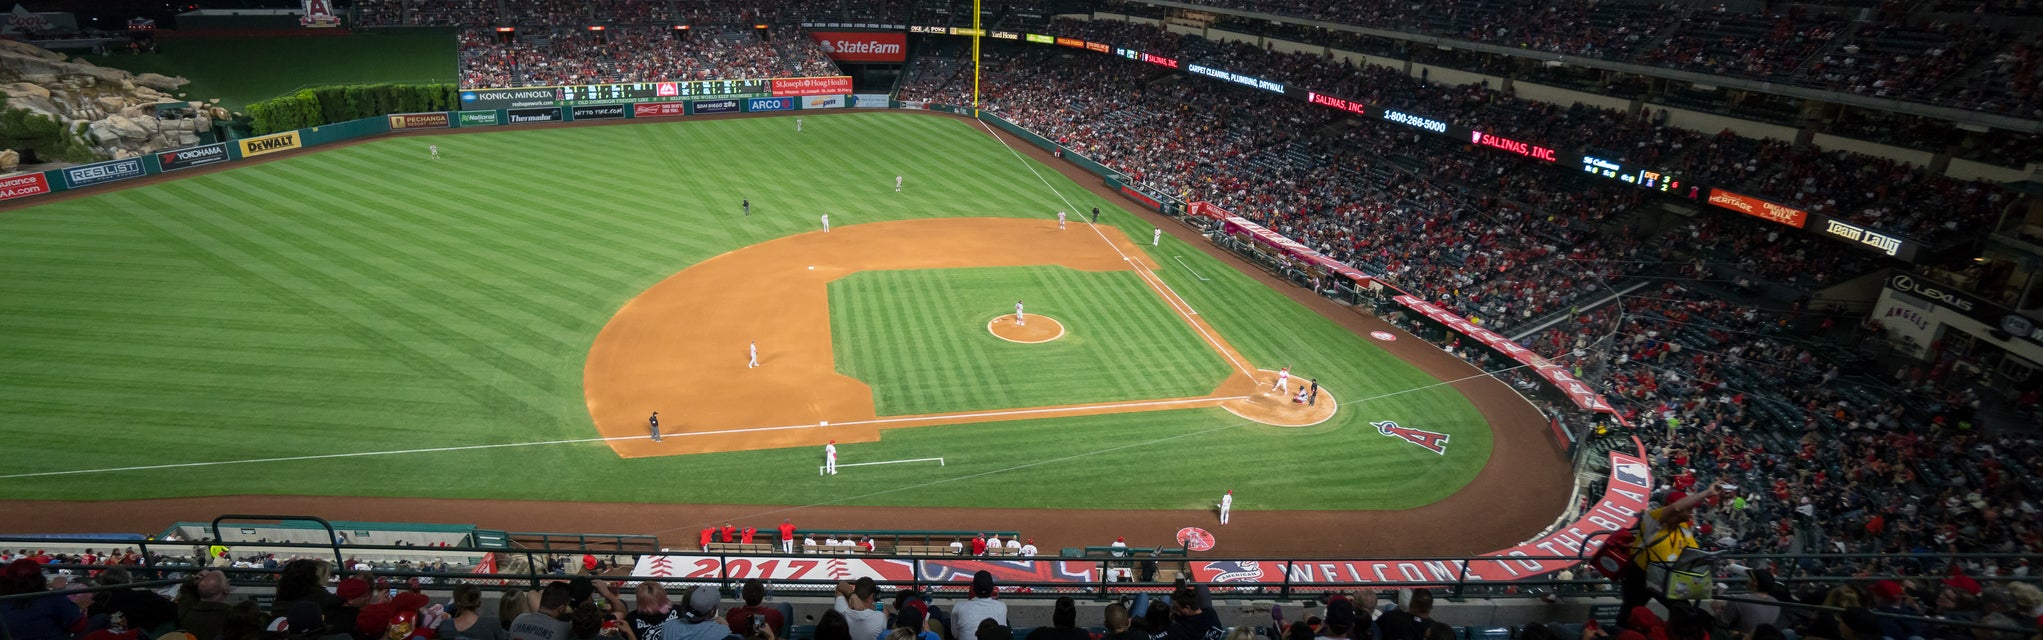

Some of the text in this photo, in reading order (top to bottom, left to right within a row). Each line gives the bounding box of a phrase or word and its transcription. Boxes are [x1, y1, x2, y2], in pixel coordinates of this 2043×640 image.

[1003, 32, 1018, 40] House
[811, 80, 827, 88] Hoag
[1188, 64, 1284, 93] CARPET CLEANING, PLUMBING, DRYWALL
[480, 92, 513, 100] KONICA
[1315, 94, 1364, 114] SALINAS, INC.
[752, 100, 780, 109] ARCO
[407, 115, 446, 123] PECHANGA
[510, 114, 552, 122] Thermador
[1384, 109, 1446, 133] 1-800-266-5000
[177, 146, 222, 160] YOKOHAMA
[1482, 134, 1556, 161] SALINAS, INC.
[1644, 171, 1660, 180] DET
[1660, 184, 1668, 192] 2
[1709, 196, 1753, 212] HERITAGE
[1763, 202, 1799, 217] ORGANIC
[1770, 209, 1791, 220] MILK
[1826, 219, 1863, 241] Team
[1861, 231, 1902, 256] Lally
[1914, 284, 1974, 311] LEXUS
[1885, 306, 1929, 331] ANGELS
[1611, 487, 1645, 503] A
[1588, 501, 1637, 531] BIG
[685, 558, 818, 579] 2017
[1222, 571, 1257, 580] AMERICAN
[1277, 560, 1483, 582] WELCOME
[513, 623, 554, 640] CHAMPIONS
